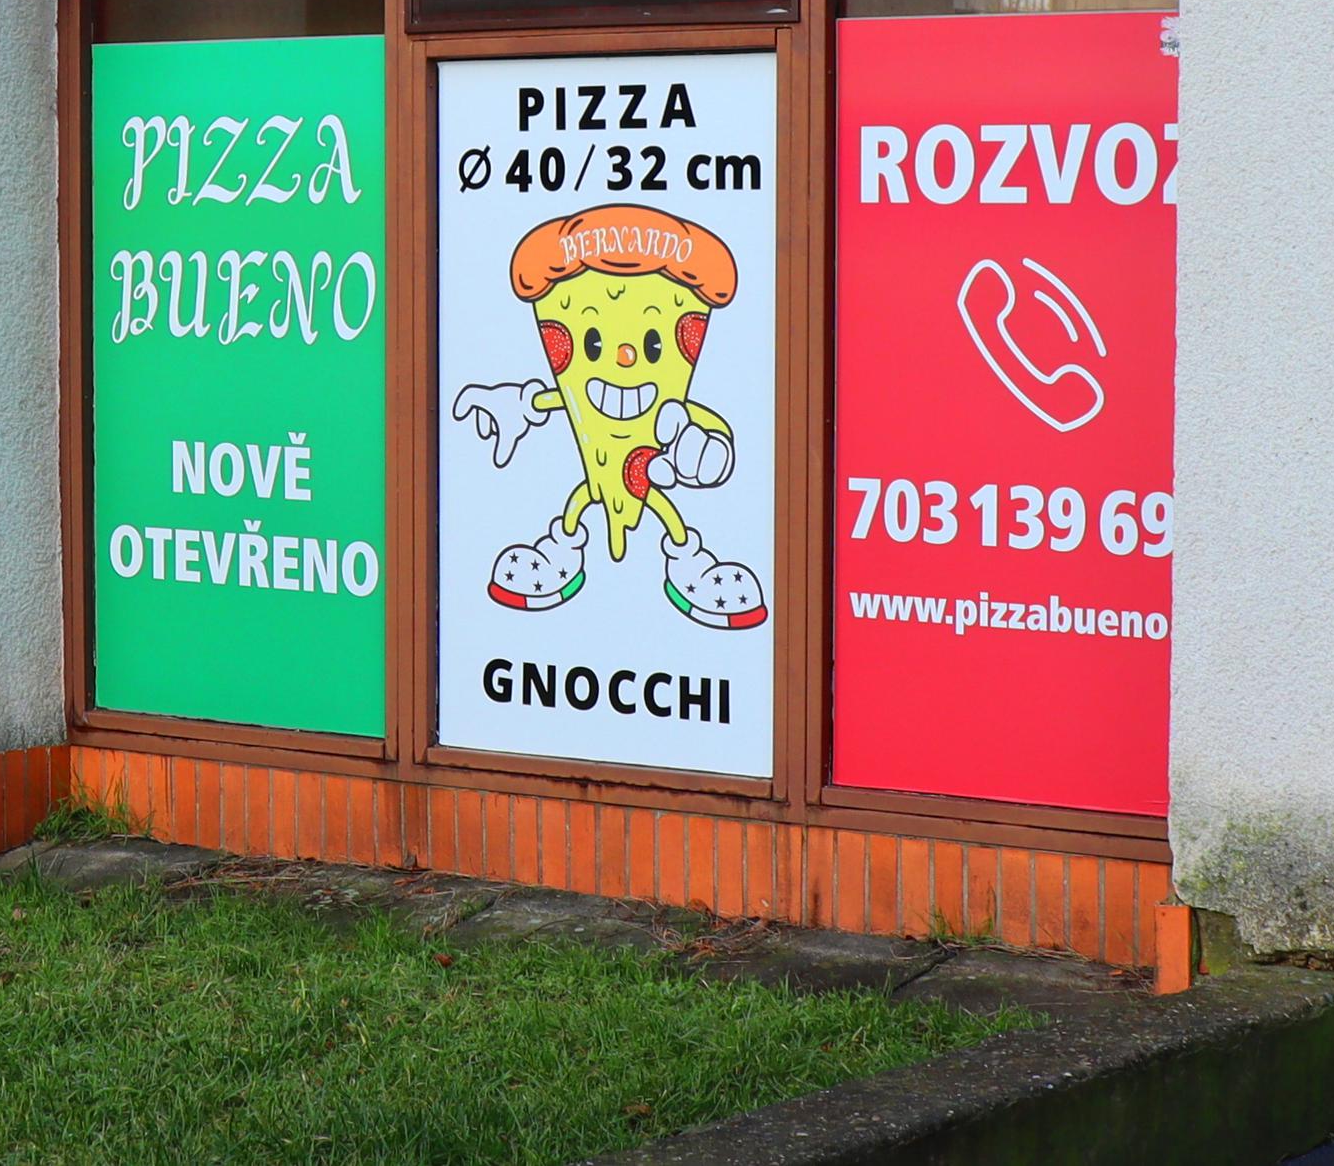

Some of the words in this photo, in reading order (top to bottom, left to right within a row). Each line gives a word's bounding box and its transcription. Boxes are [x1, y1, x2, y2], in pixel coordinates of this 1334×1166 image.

[518, 83, 696, 133] PIZZA
[121, 113, 362, 211] PIZZA
[686, 147, 762, 191] cm
[559, 225, 693, 265] BERNARDO
[109, 249, 378, 346] BUENO
[172, 431, 313, 502] NOVĚ
[848, 477, 958, 545] 703
[969, 484, 1086, 553] 139
[109, 520, 379, 596] OTEVŘENO
[482, 658, 731, 724] GNOCCHI
